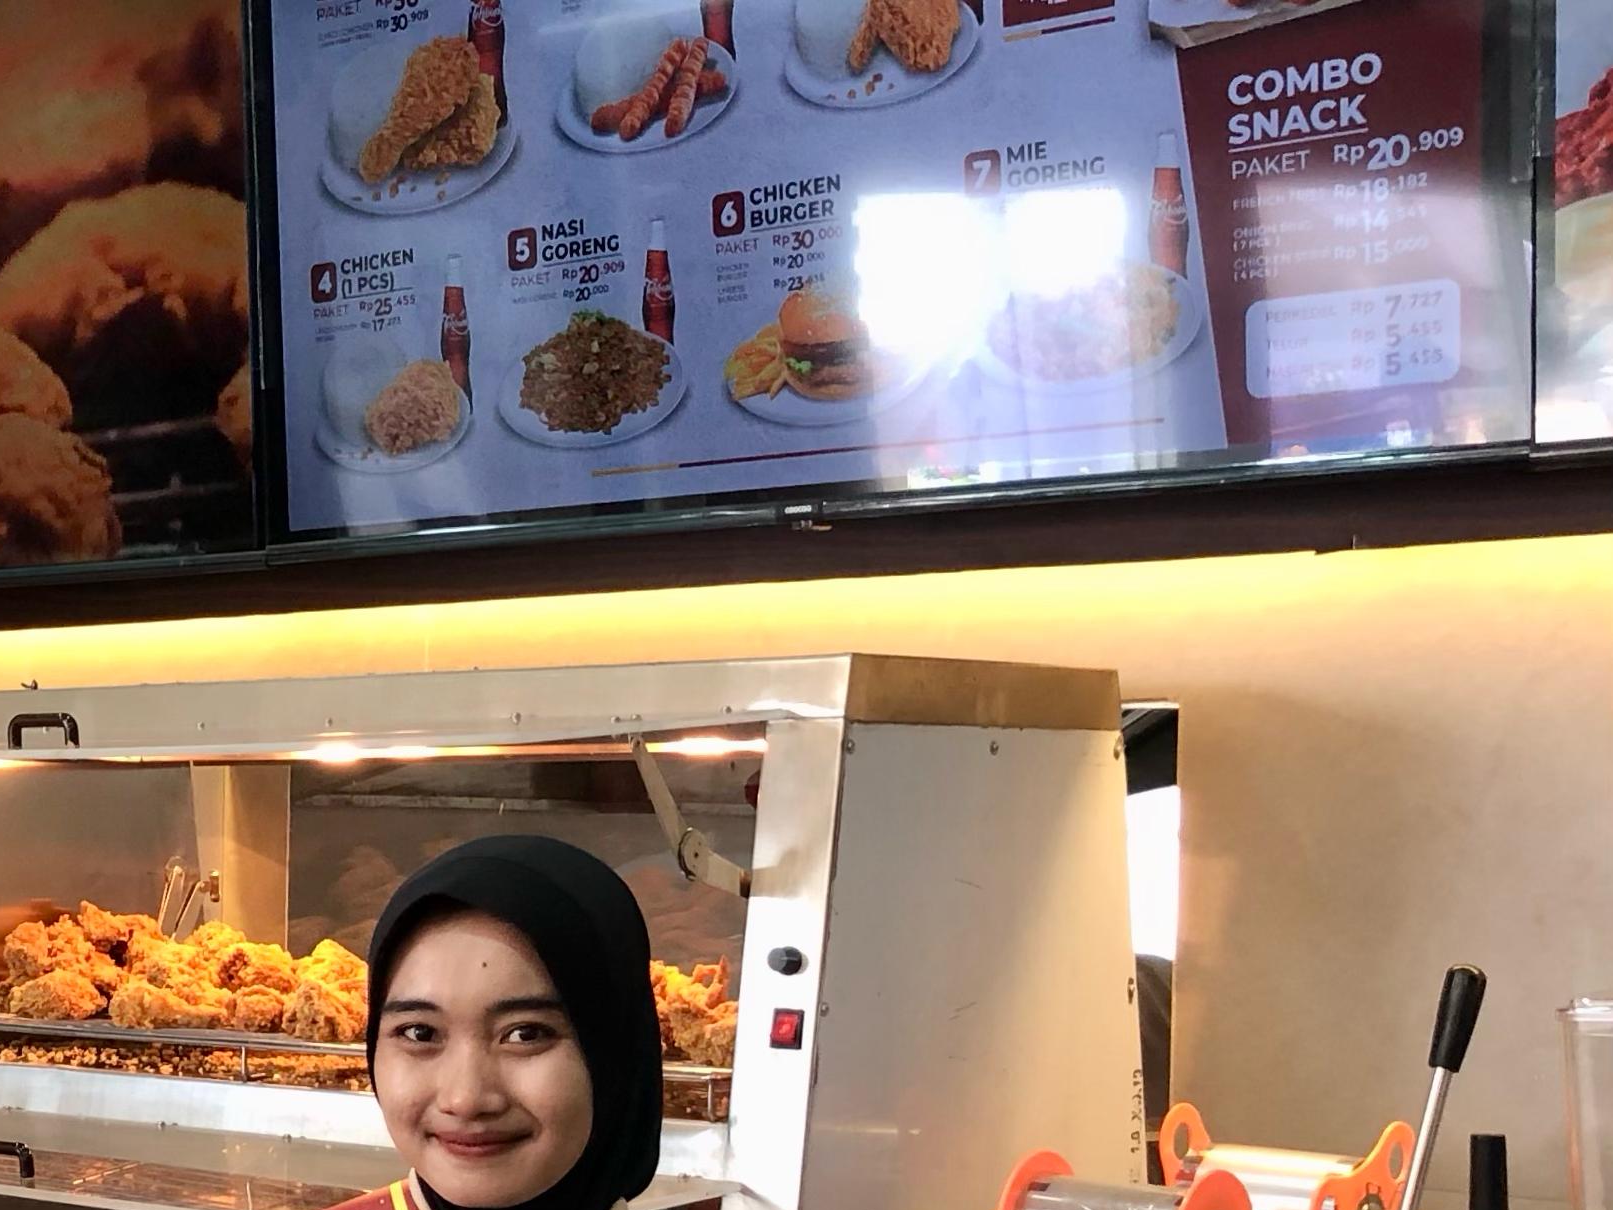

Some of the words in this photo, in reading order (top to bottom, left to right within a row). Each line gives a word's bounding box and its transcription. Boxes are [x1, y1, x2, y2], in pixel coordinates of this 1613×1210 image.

[1227, 52, 1382, 106] COMBO
[1228, 94, 1367, 145] SNACK
[1006, 141, 1047, 164] MIE
[1231, 150, 1311, 179] PAKET
[972, 160, 991, 190] 7
[1008, 156, 1104, 188] GORENG
[750, 174, 840, 205] CHICKEN
[720, 200, 738, 228] 6
[750, 199, 834, 228] BURGER
[541, 218, 584, 241] NASI
[515, 237, 530, 263] 5
[542, 235, 619, 261] GORENG
[715, 238, 759, 255] PAKET
[341, 248, 414, 274] CHICKEN
[318, 270, 333, 294] 4
[358, 271, 394, 292] PCS)
[511, 272, 551, 287] PAKET
